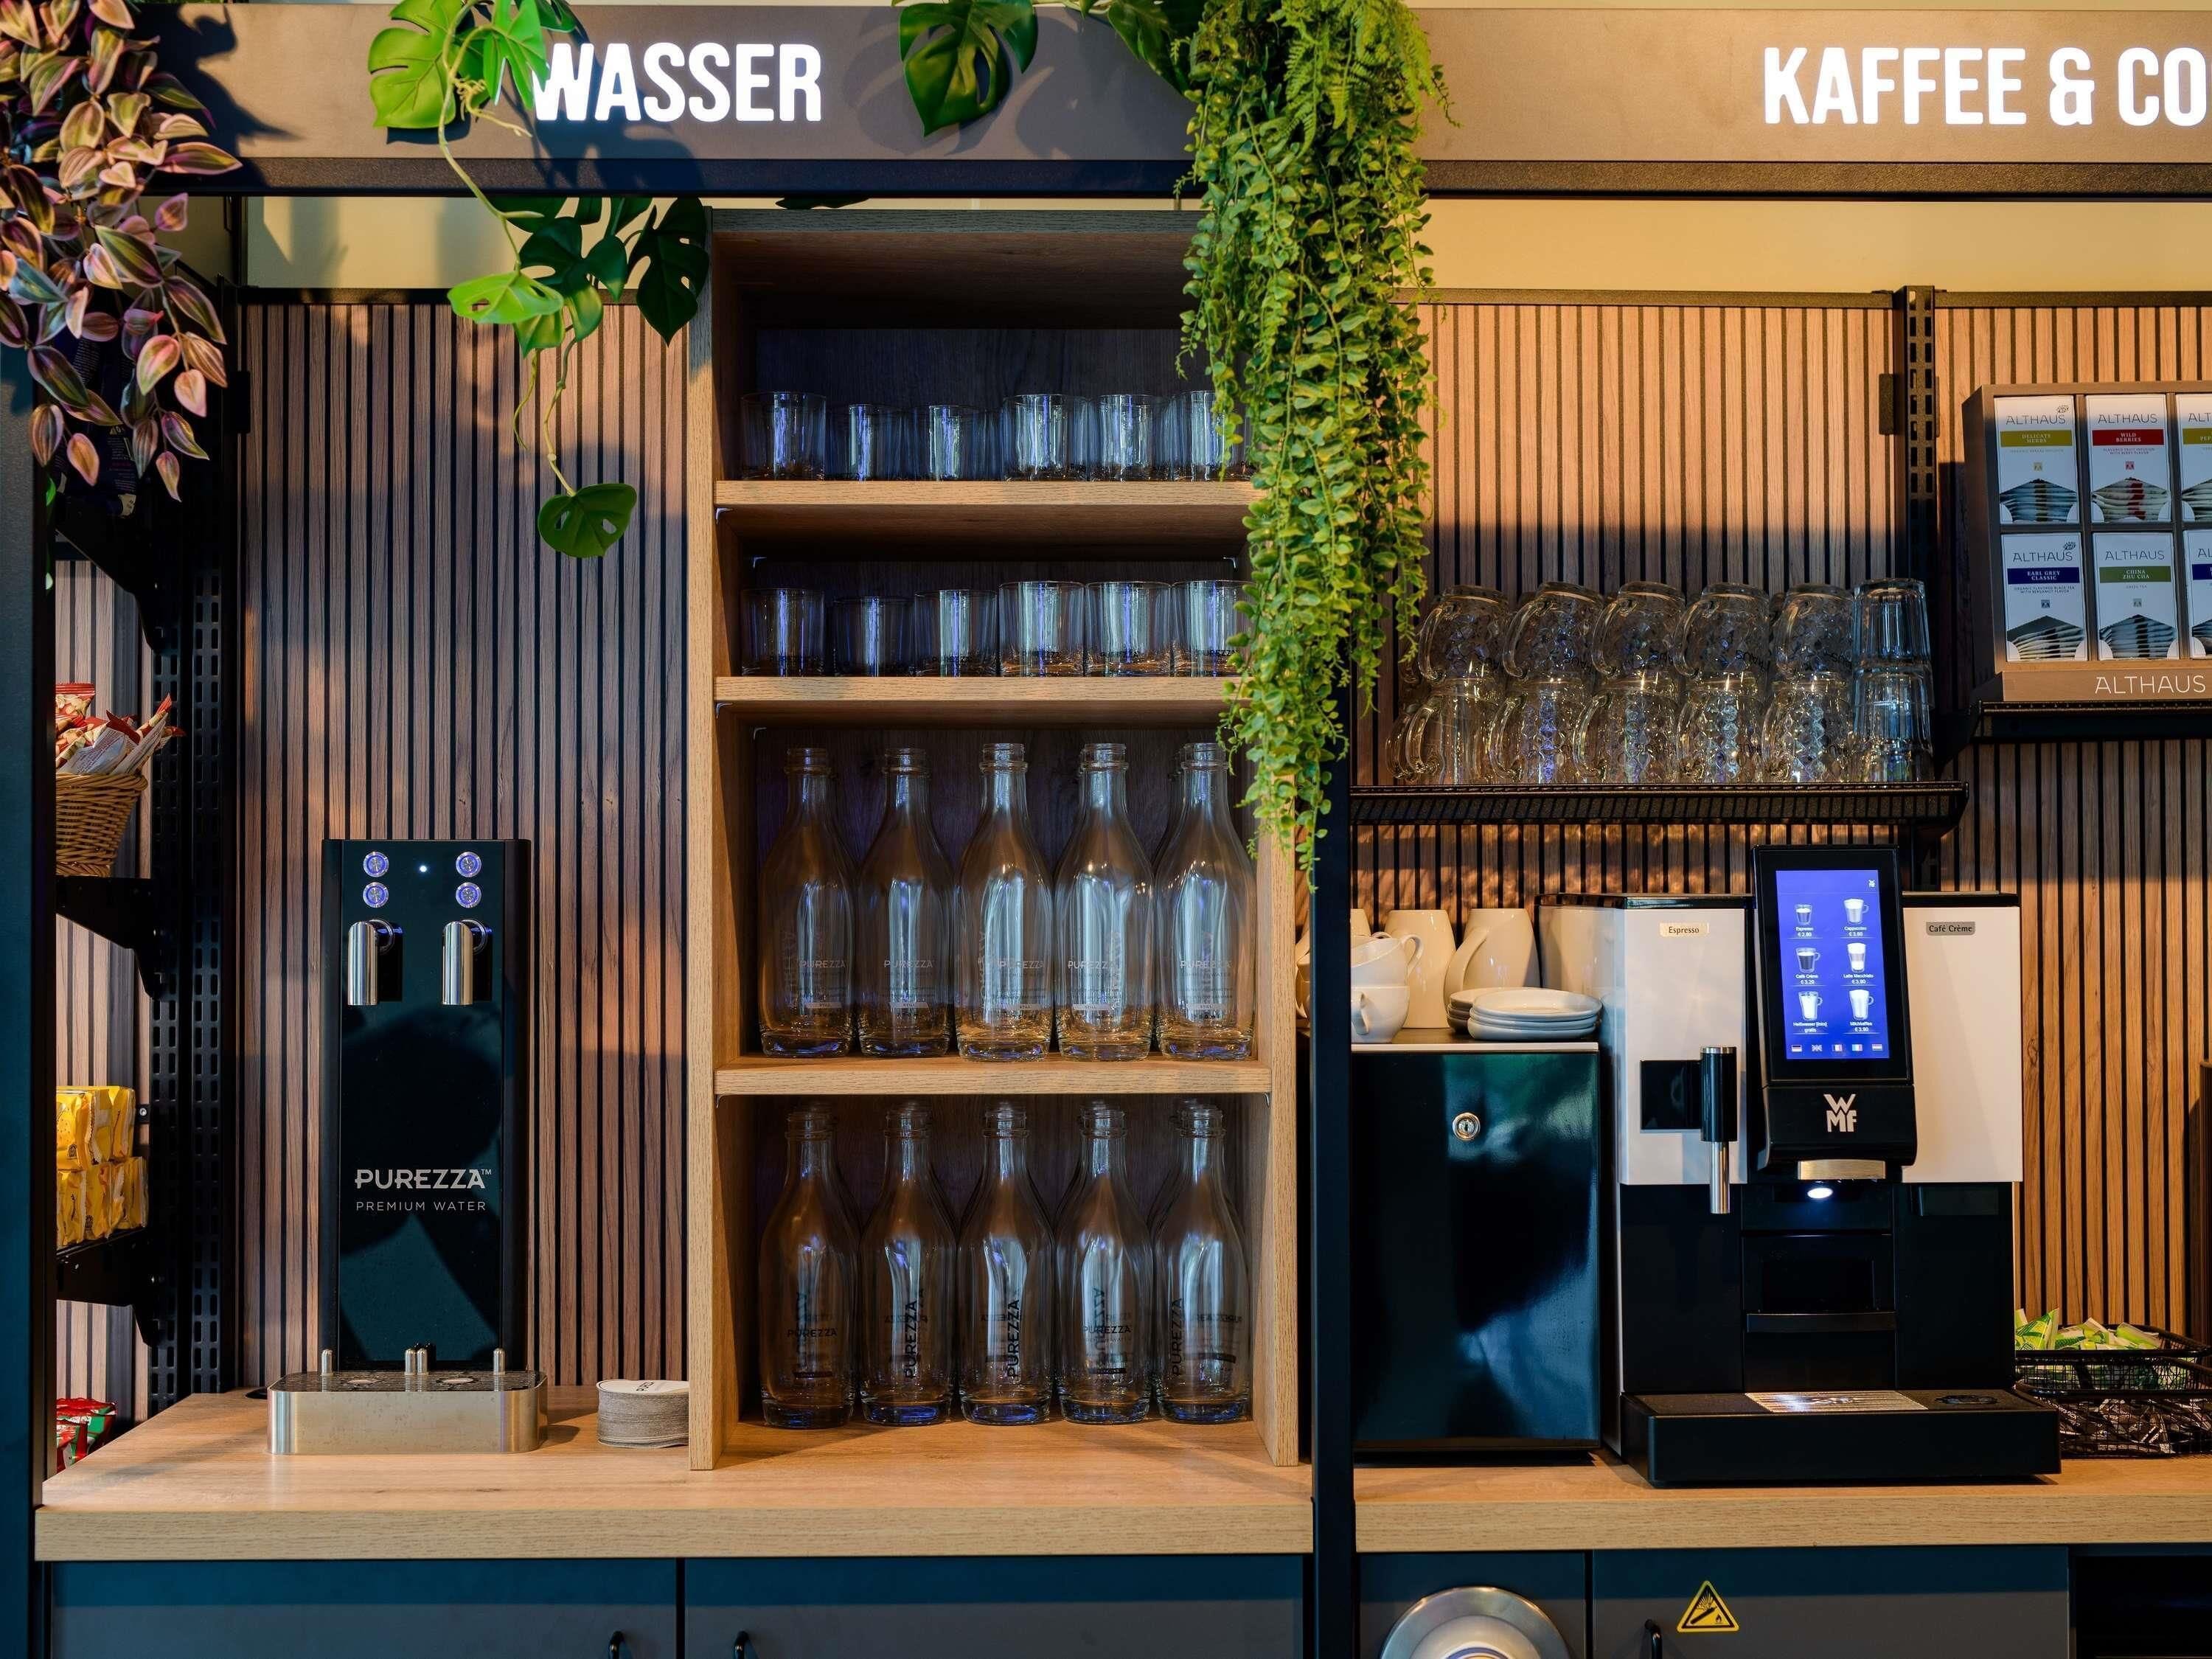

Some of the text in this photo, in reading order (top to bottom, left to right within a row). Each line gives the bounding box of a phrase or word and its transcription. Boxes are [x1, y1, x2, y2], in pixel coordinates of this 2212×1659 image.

[532, 42, 821, 122] WASSER
[1764, 47, 2207, 126] KAFFEE & CO
[2006, 414, 2066, 425] ALTHAUS
[2098, 414, 2157, 424] ALTHAUS
[2012, 551, 2073, 562] ALTHAUS
[2105, 550, 2166, 560] ALTHAUS
[2095, 675, 2206, 695] ALTHAUS
[1669, 926, 1700, 936] Espresso
[799, 960, 846, 968] PUREZZA
[1823, 1093, 1857, 1133] WMF
[356, 1202, 486, 1211] PREMIUM WATER
[905, 1301, 917, 1379] PUREZZA
[1007, 1300, 1019, 1377] PUREZZA
